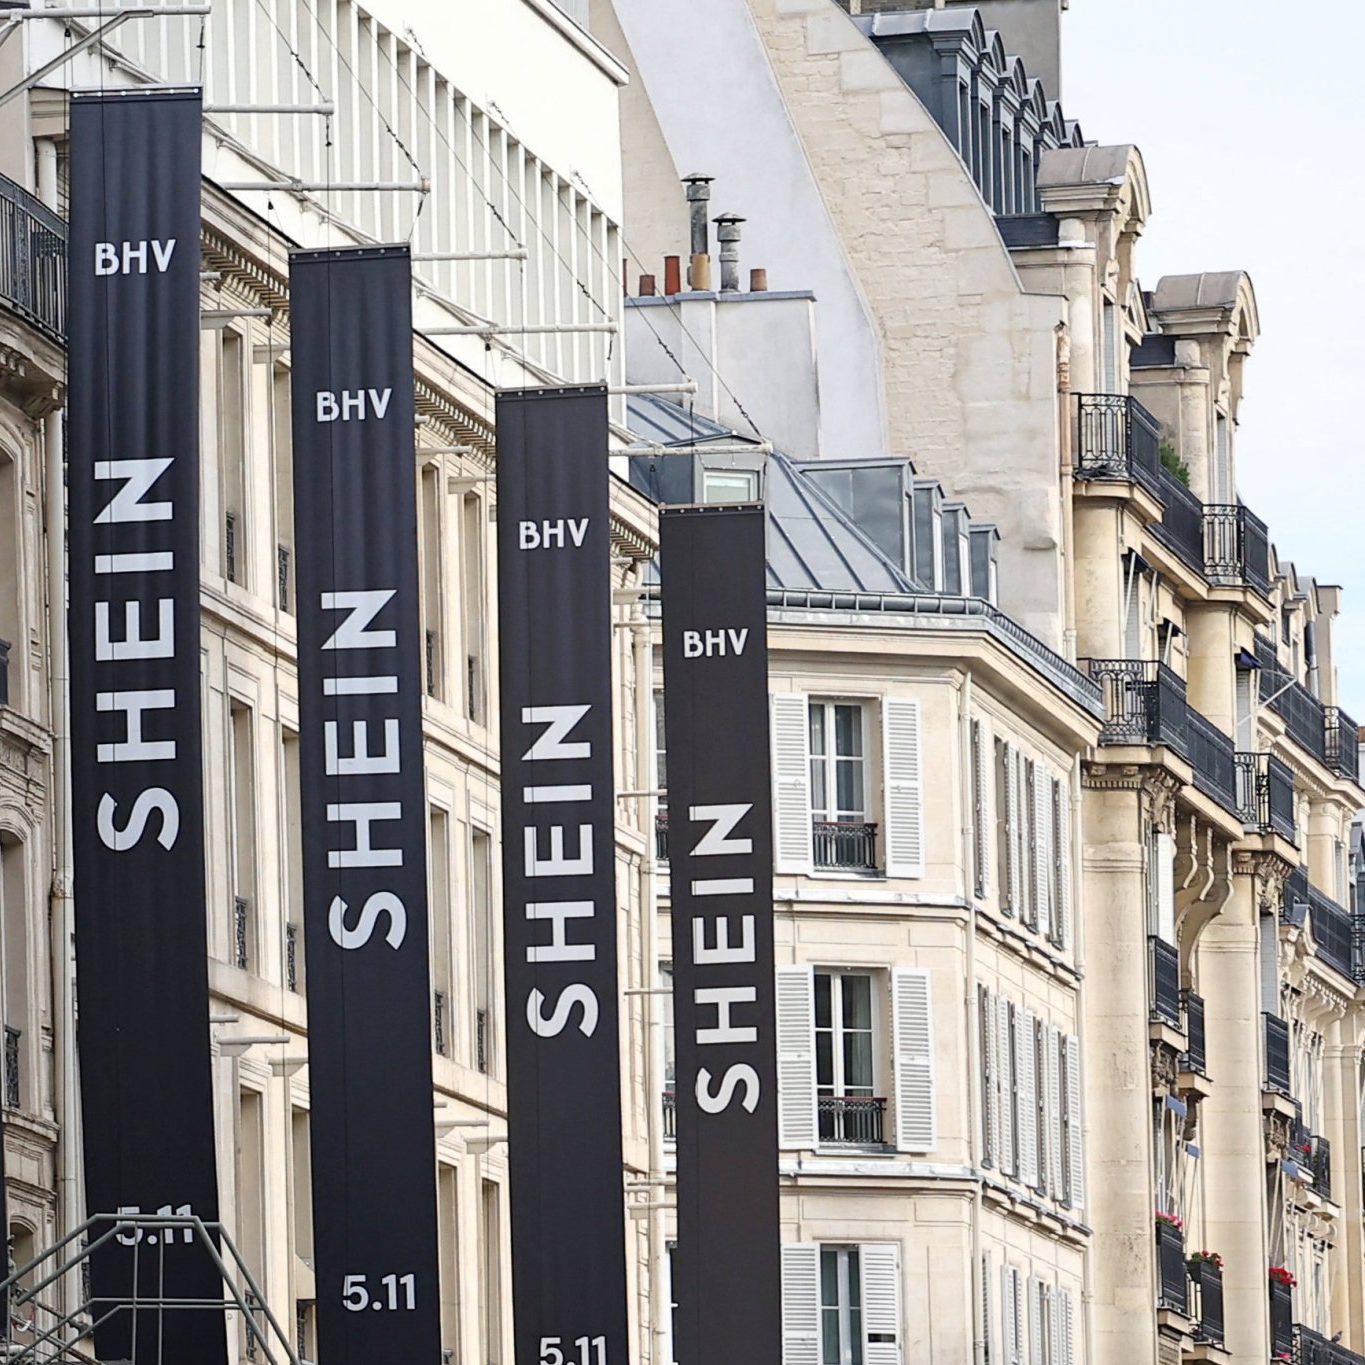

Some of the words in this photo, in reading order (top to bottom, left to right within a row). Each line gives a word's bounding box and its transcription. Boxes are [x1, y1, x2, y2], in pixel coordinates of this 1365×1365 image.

[94, 238, 177, 277] BHV
[315, 387, 394, 423] BHV
[518, 517, 590, 551] BHV
[92, 456, 180, 852] SHEIN
[682, 627, 750, 660] BHV
[320, 588, 407, 952] SHEIN
[520, 703, 600, 1040] SHEIN
[688, 802, 761, 1115] SHEIN
[114, 1203, 195, 1246] 5.11
[341, 1272, 417, 1313] 5.11
